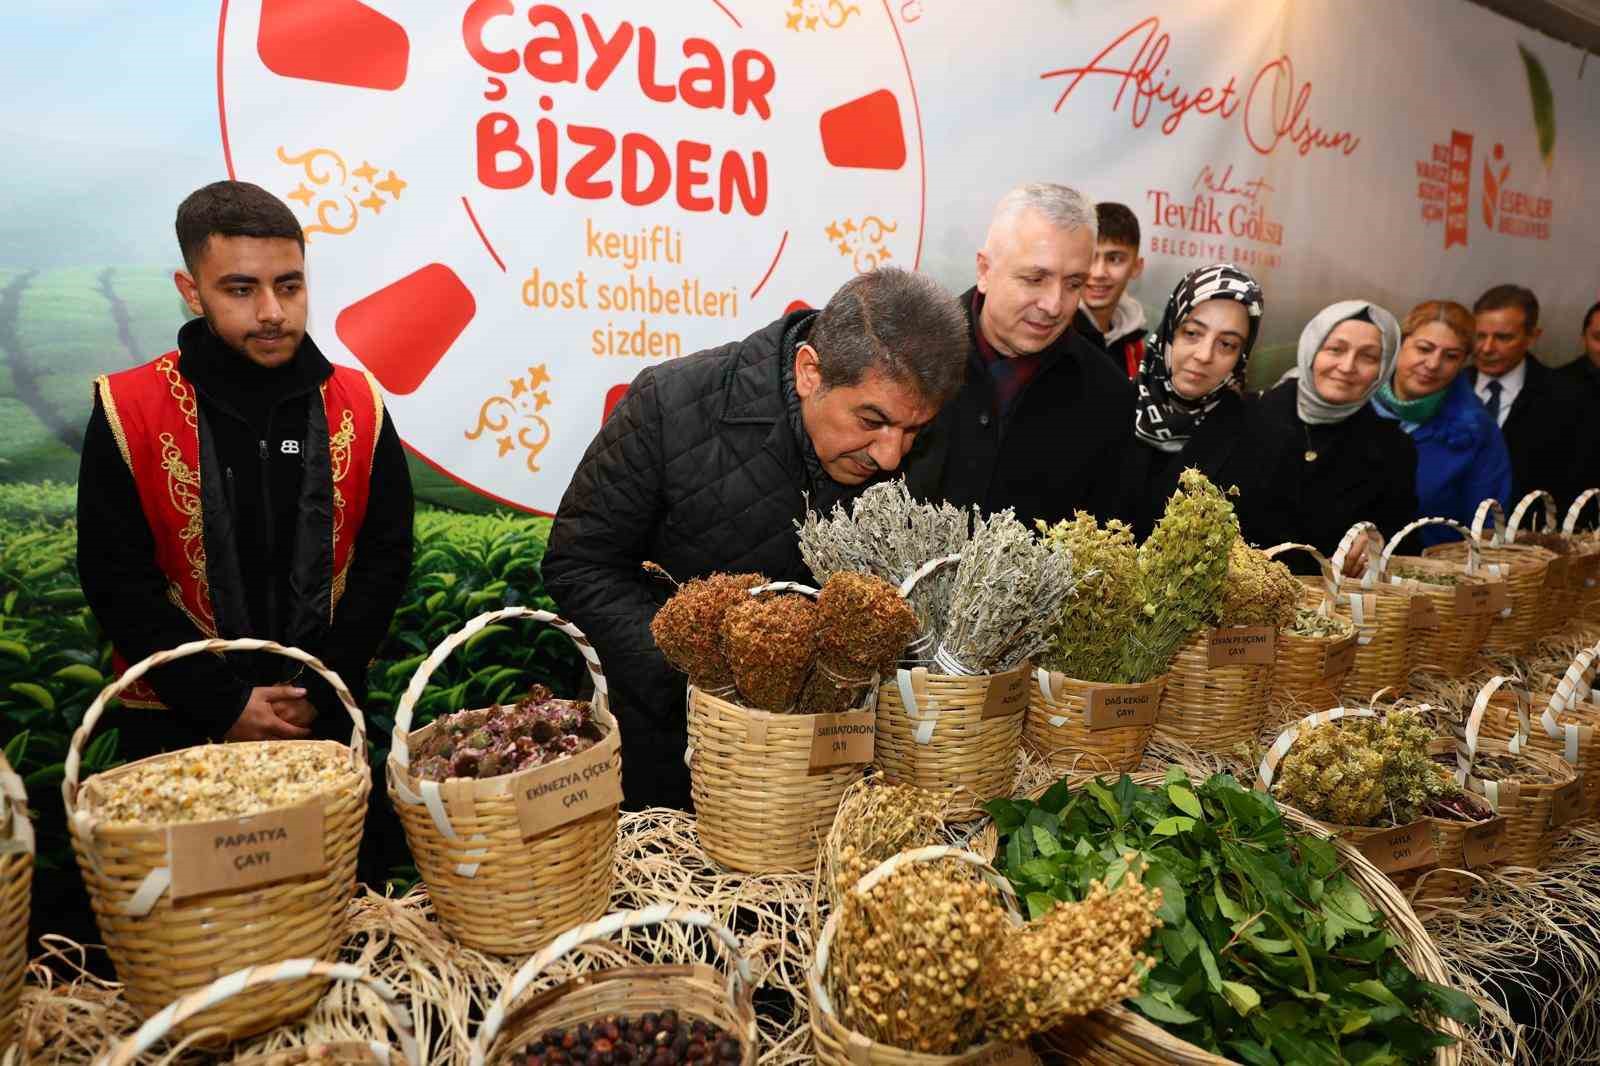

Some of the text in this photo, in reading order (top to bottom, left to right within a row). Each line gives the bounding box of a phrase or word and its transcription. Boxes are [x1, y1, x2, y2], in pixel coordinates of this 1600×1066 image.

[1040, 16, 1360, 155] Afiyet Olsun
[476, 95, 768, 216] BİZDEN
[1147, 189, 1223, 235] Tevfik
[586, 218, 683, 269] keyifli
[522, 266, 738, 318] dost sohbetleri
[592, 319, 681, 358] sizden
[526, 760, 612, 800] EKİNEZYA ÇİÇEK
[562, 789, 589, 808] ÇAYI
[214, 827, 288, 849] PAPATYA
[233, 851, 271, 871] ÇAYI
